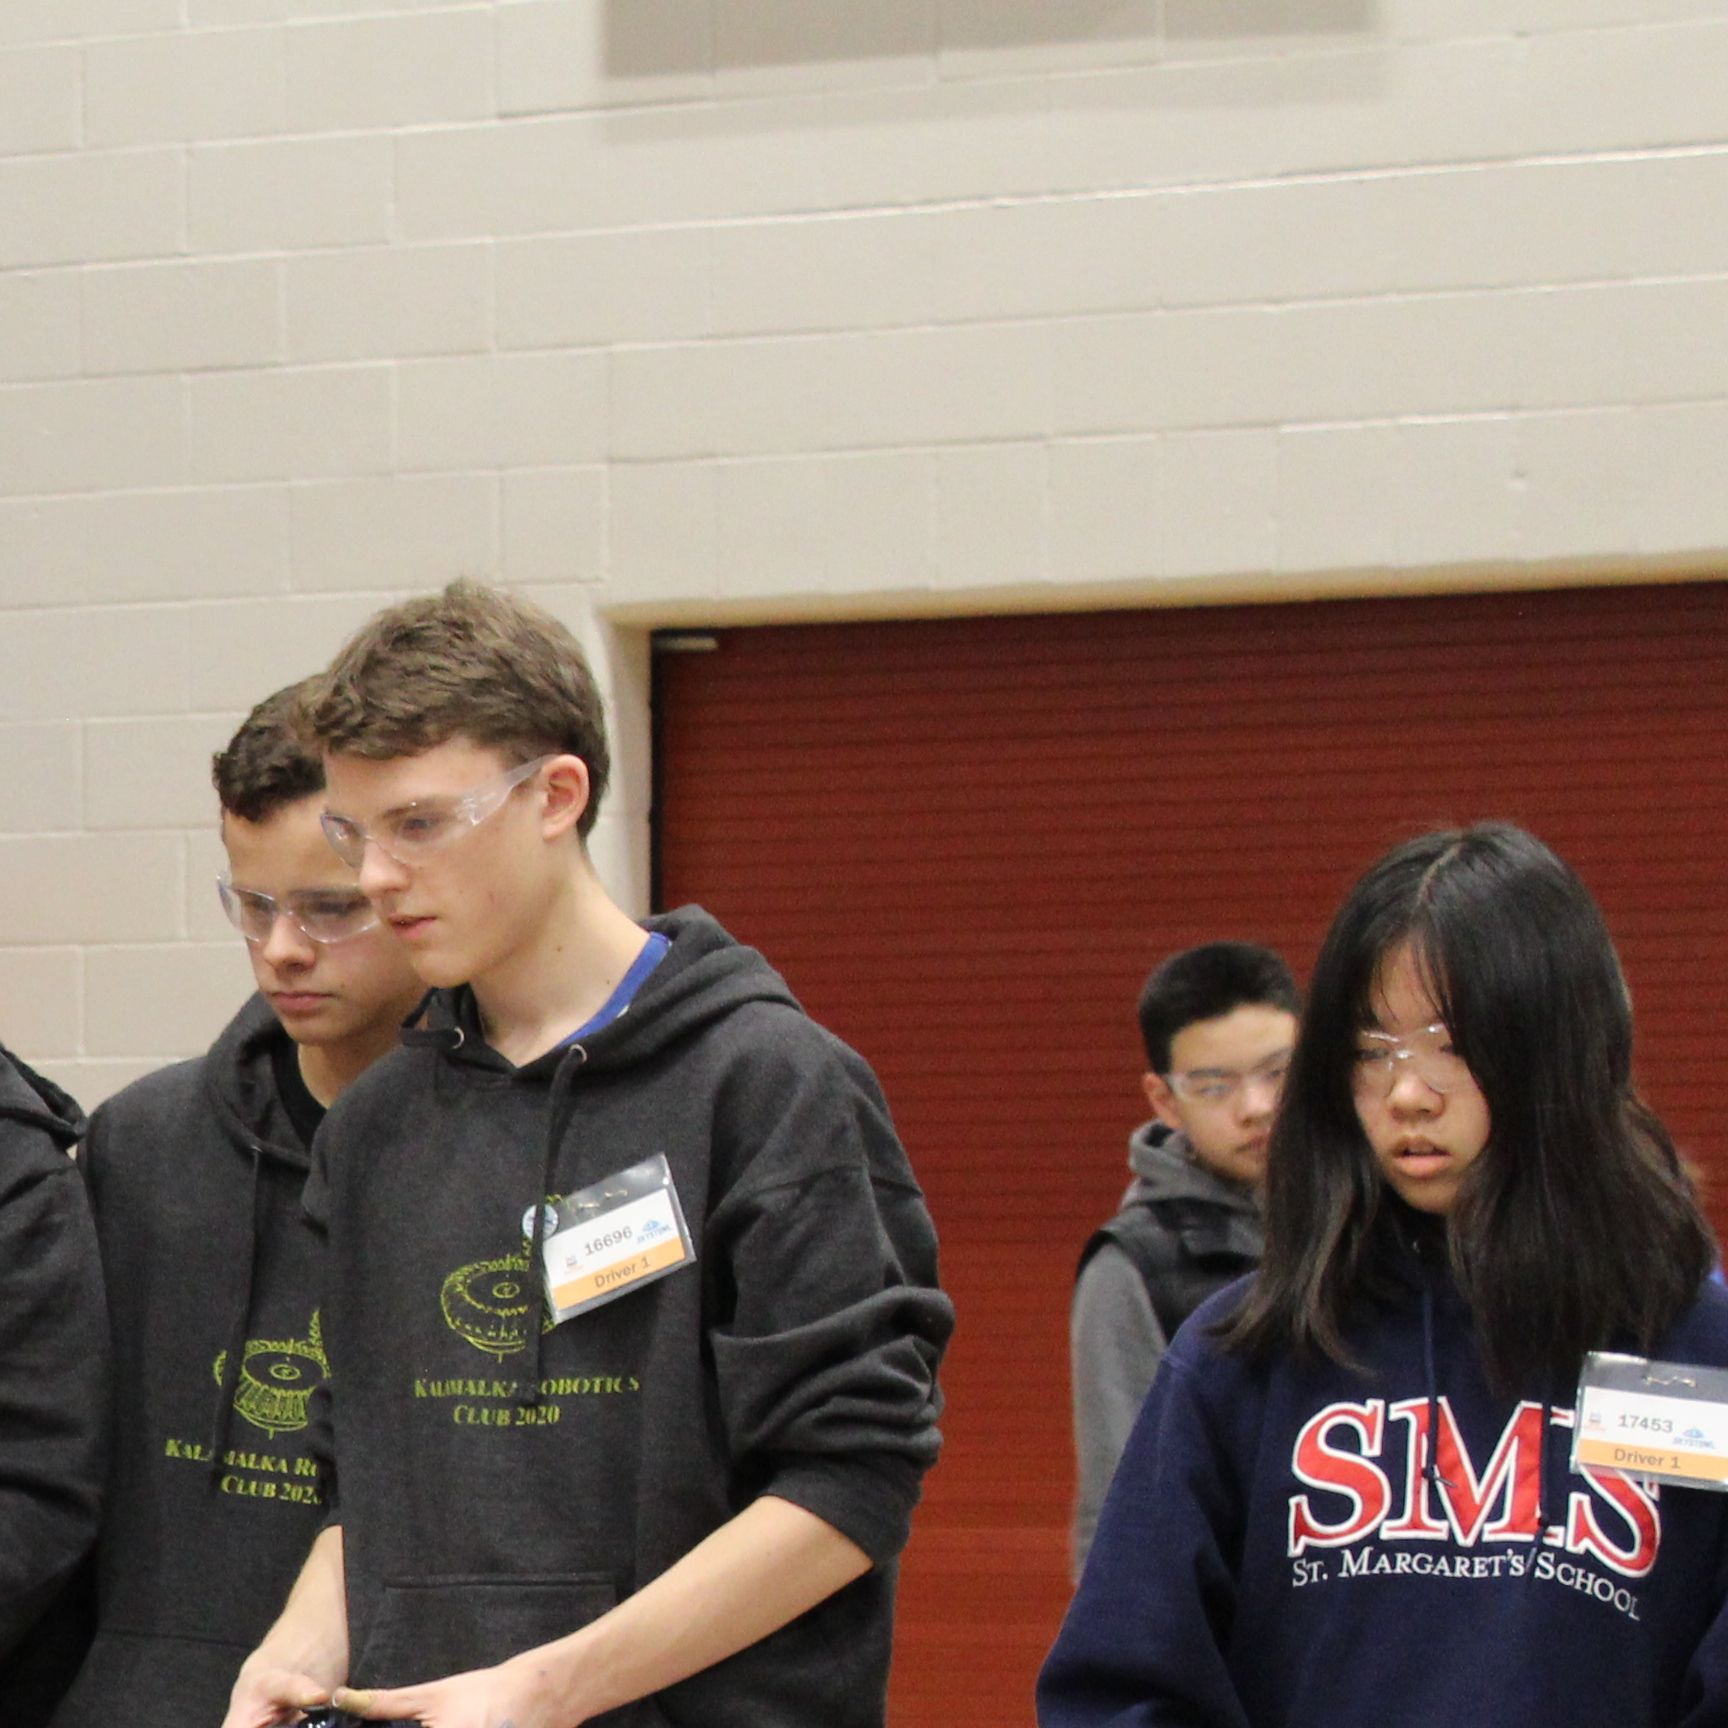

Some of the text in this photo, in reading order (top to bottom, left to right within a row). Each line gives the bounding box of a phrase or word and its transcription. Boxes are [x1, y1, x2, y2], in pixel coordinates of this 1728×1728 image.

[583, 1226, 633, 1256] 16696
[594, 1263, 637, 1288] Driver
[642, 1256, 651, 1269] 1
[541, 1376, 641, 1396] OBOTICS
[452, 1404, 562, 1427] CLUB 2020
[1618, 1414, 1674, 1433] 17453
[1614, 1448, 1681, 1469] Driver 1
[220, 1475, 322, 1504] CLUB 202
[1337, 1545, 1526, 1578] MARGARET'S
[1534, 1551, 1641, 1621] SCHOOL
